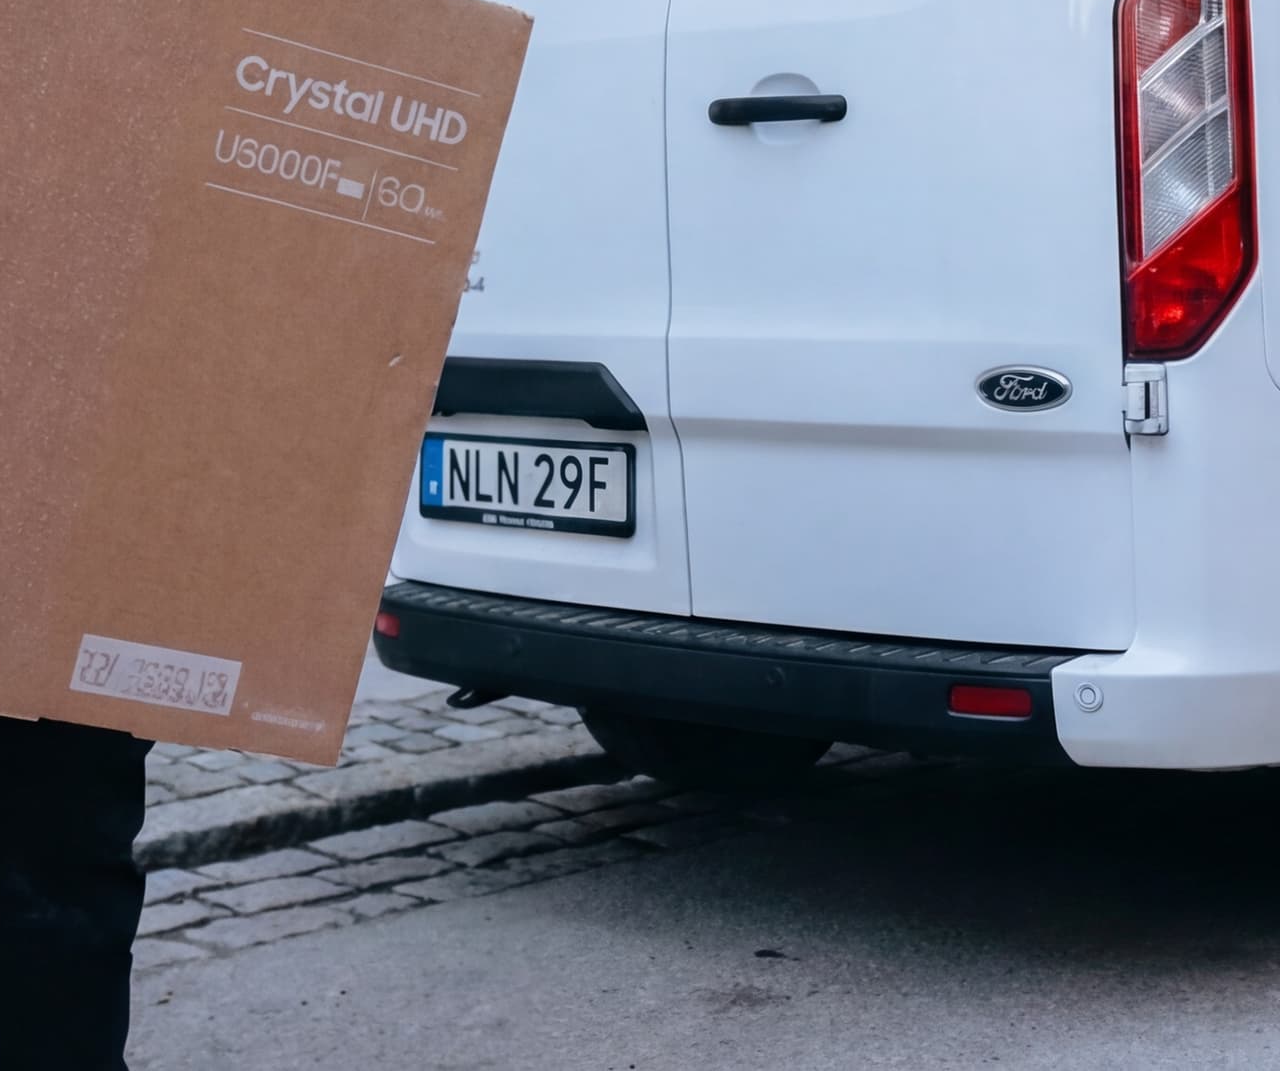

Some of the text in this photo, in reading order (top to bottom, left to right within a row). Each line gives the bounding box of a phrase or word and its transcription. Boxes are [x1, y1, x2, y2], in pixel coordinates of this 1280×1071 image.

[236, 55, 467, 145] Crystal UHD
[994, 374, 1048, 400] Ford
[449, 448, 609, 512] NLN 29F
